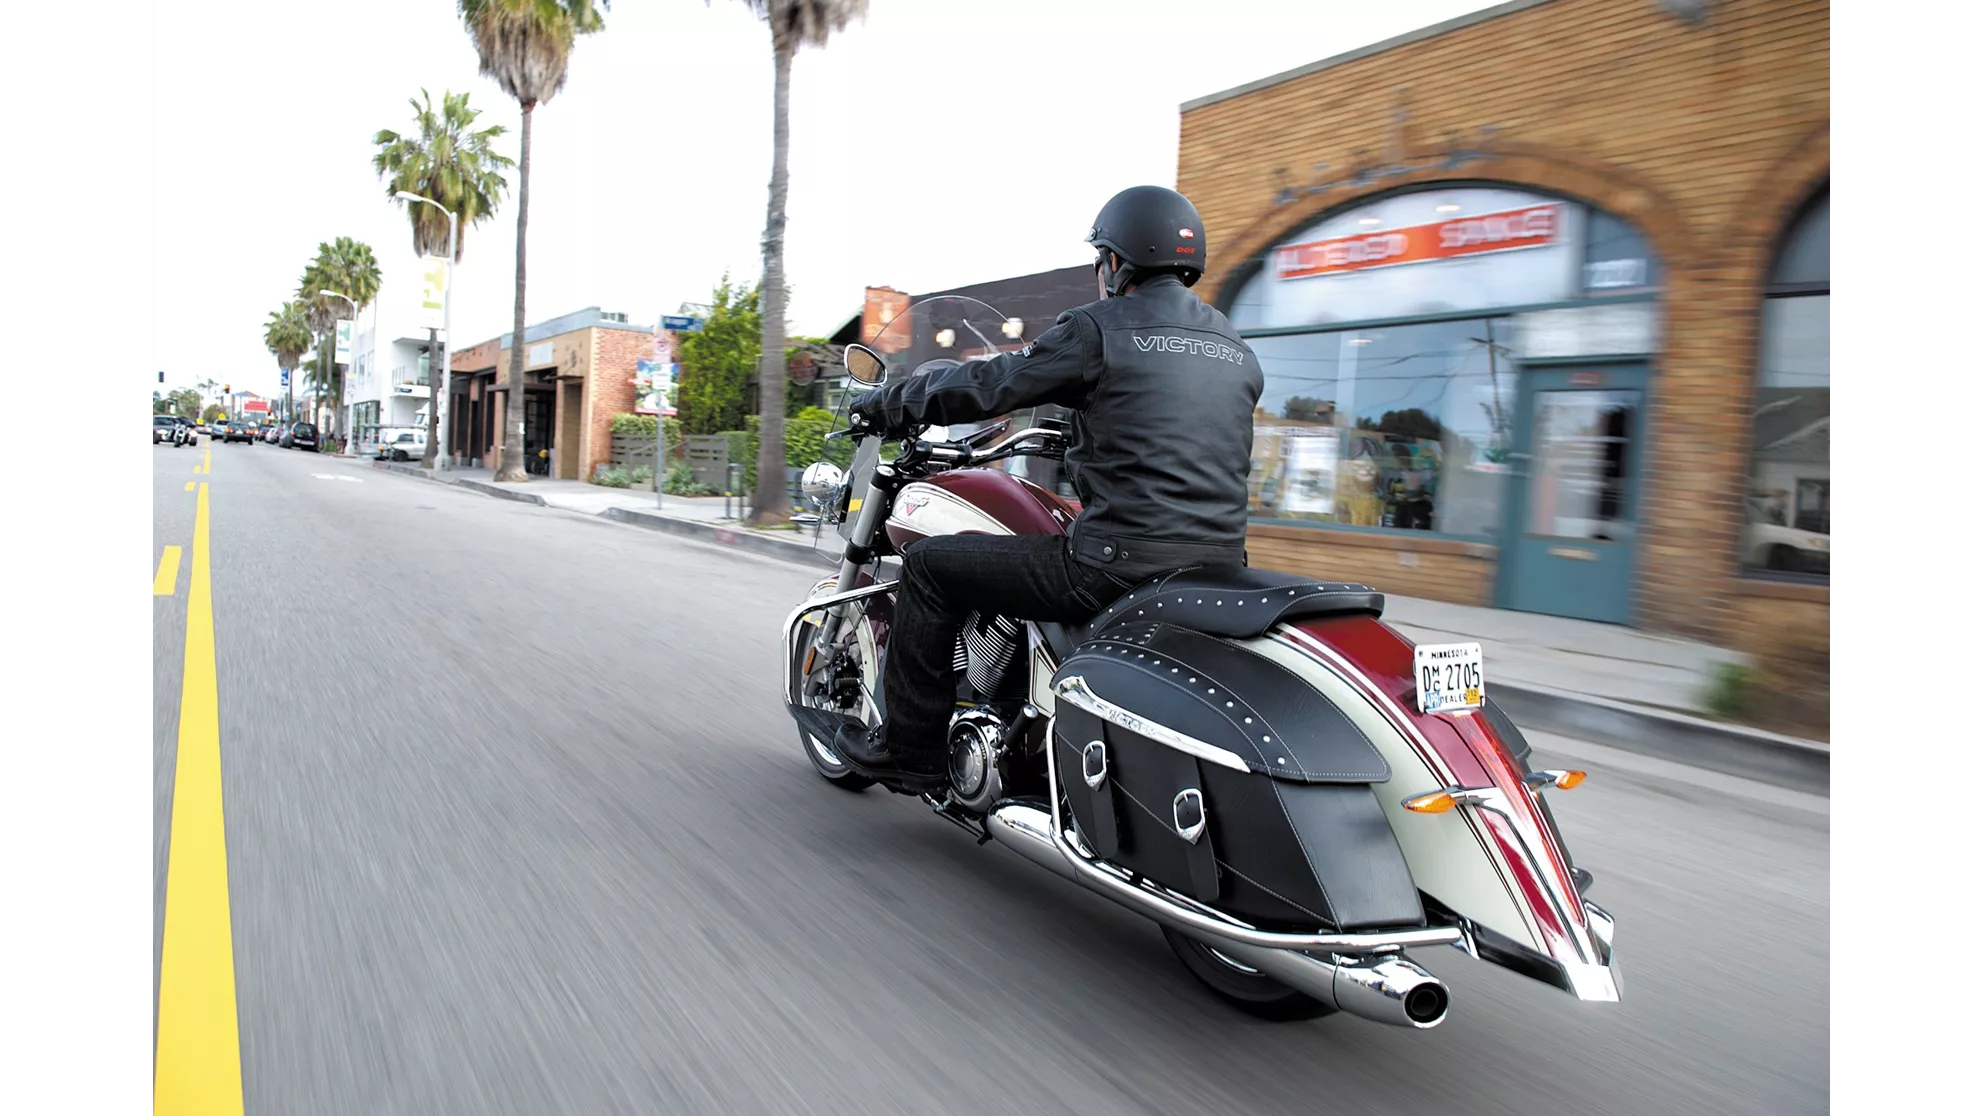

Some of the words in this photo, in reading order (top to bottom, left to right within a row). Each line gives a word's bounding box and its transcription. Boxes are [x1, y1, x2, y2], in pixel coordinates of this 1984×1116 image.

[1133, 335, 1244, 365] VICTORY
[1431, 649, 1468, 659] MINNESOTA
[1445, 662, 1480, 691] 2705
